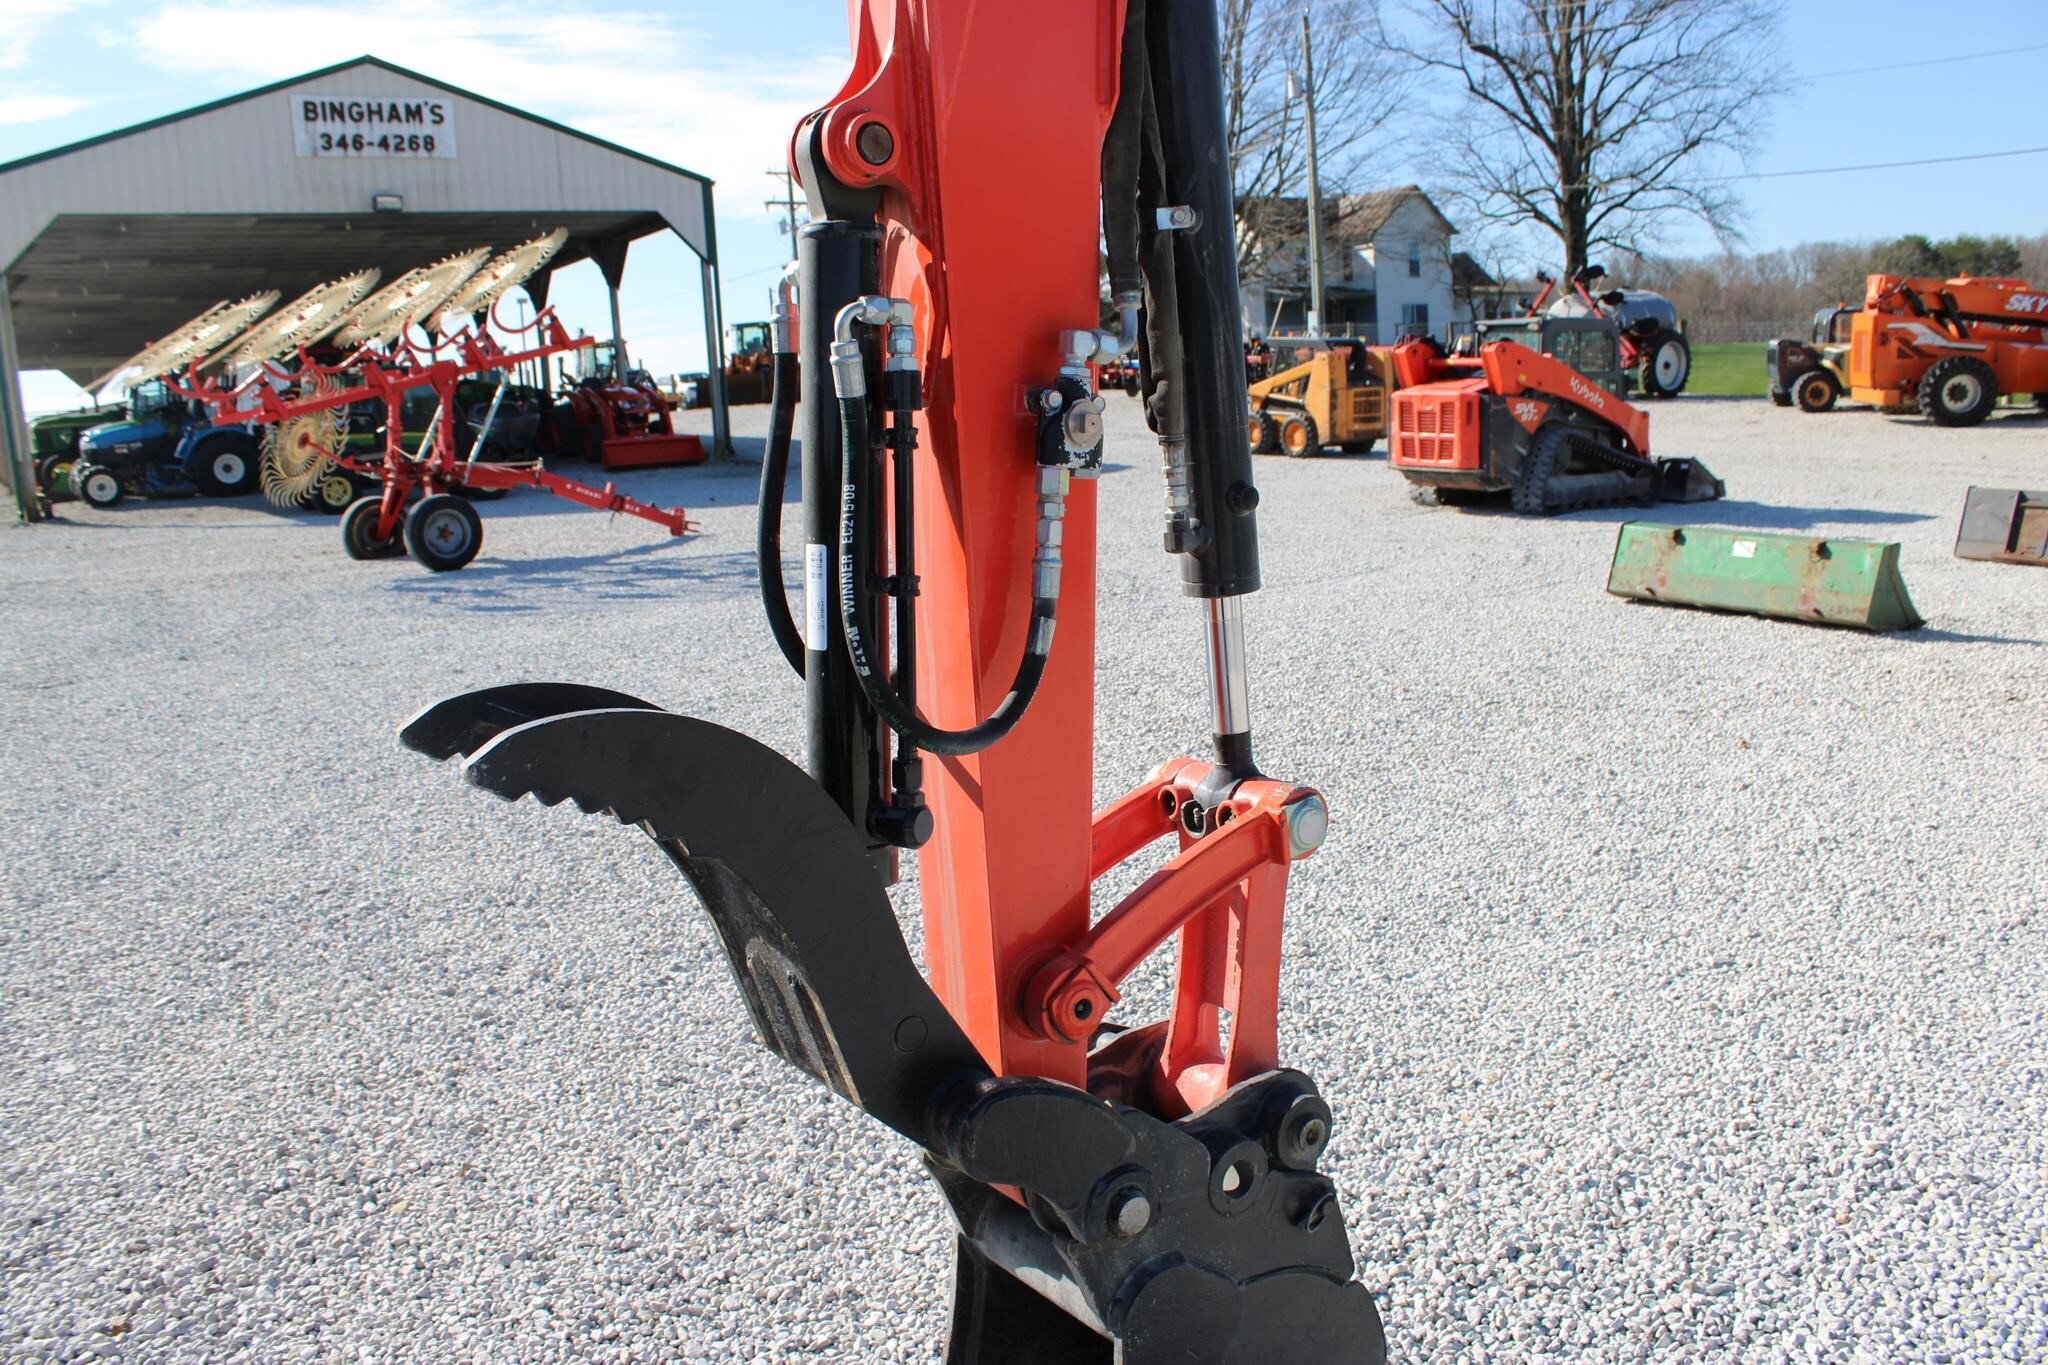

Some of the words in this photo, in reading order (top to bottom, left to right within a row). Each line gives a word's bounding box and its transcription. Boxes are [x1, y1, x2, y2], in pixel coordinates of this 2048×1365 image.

[303, 100, 445, 125] BINGHAM'S
[320, 133, 436, 152] 346-4268
[841, 554, 856, 615] WINNER
